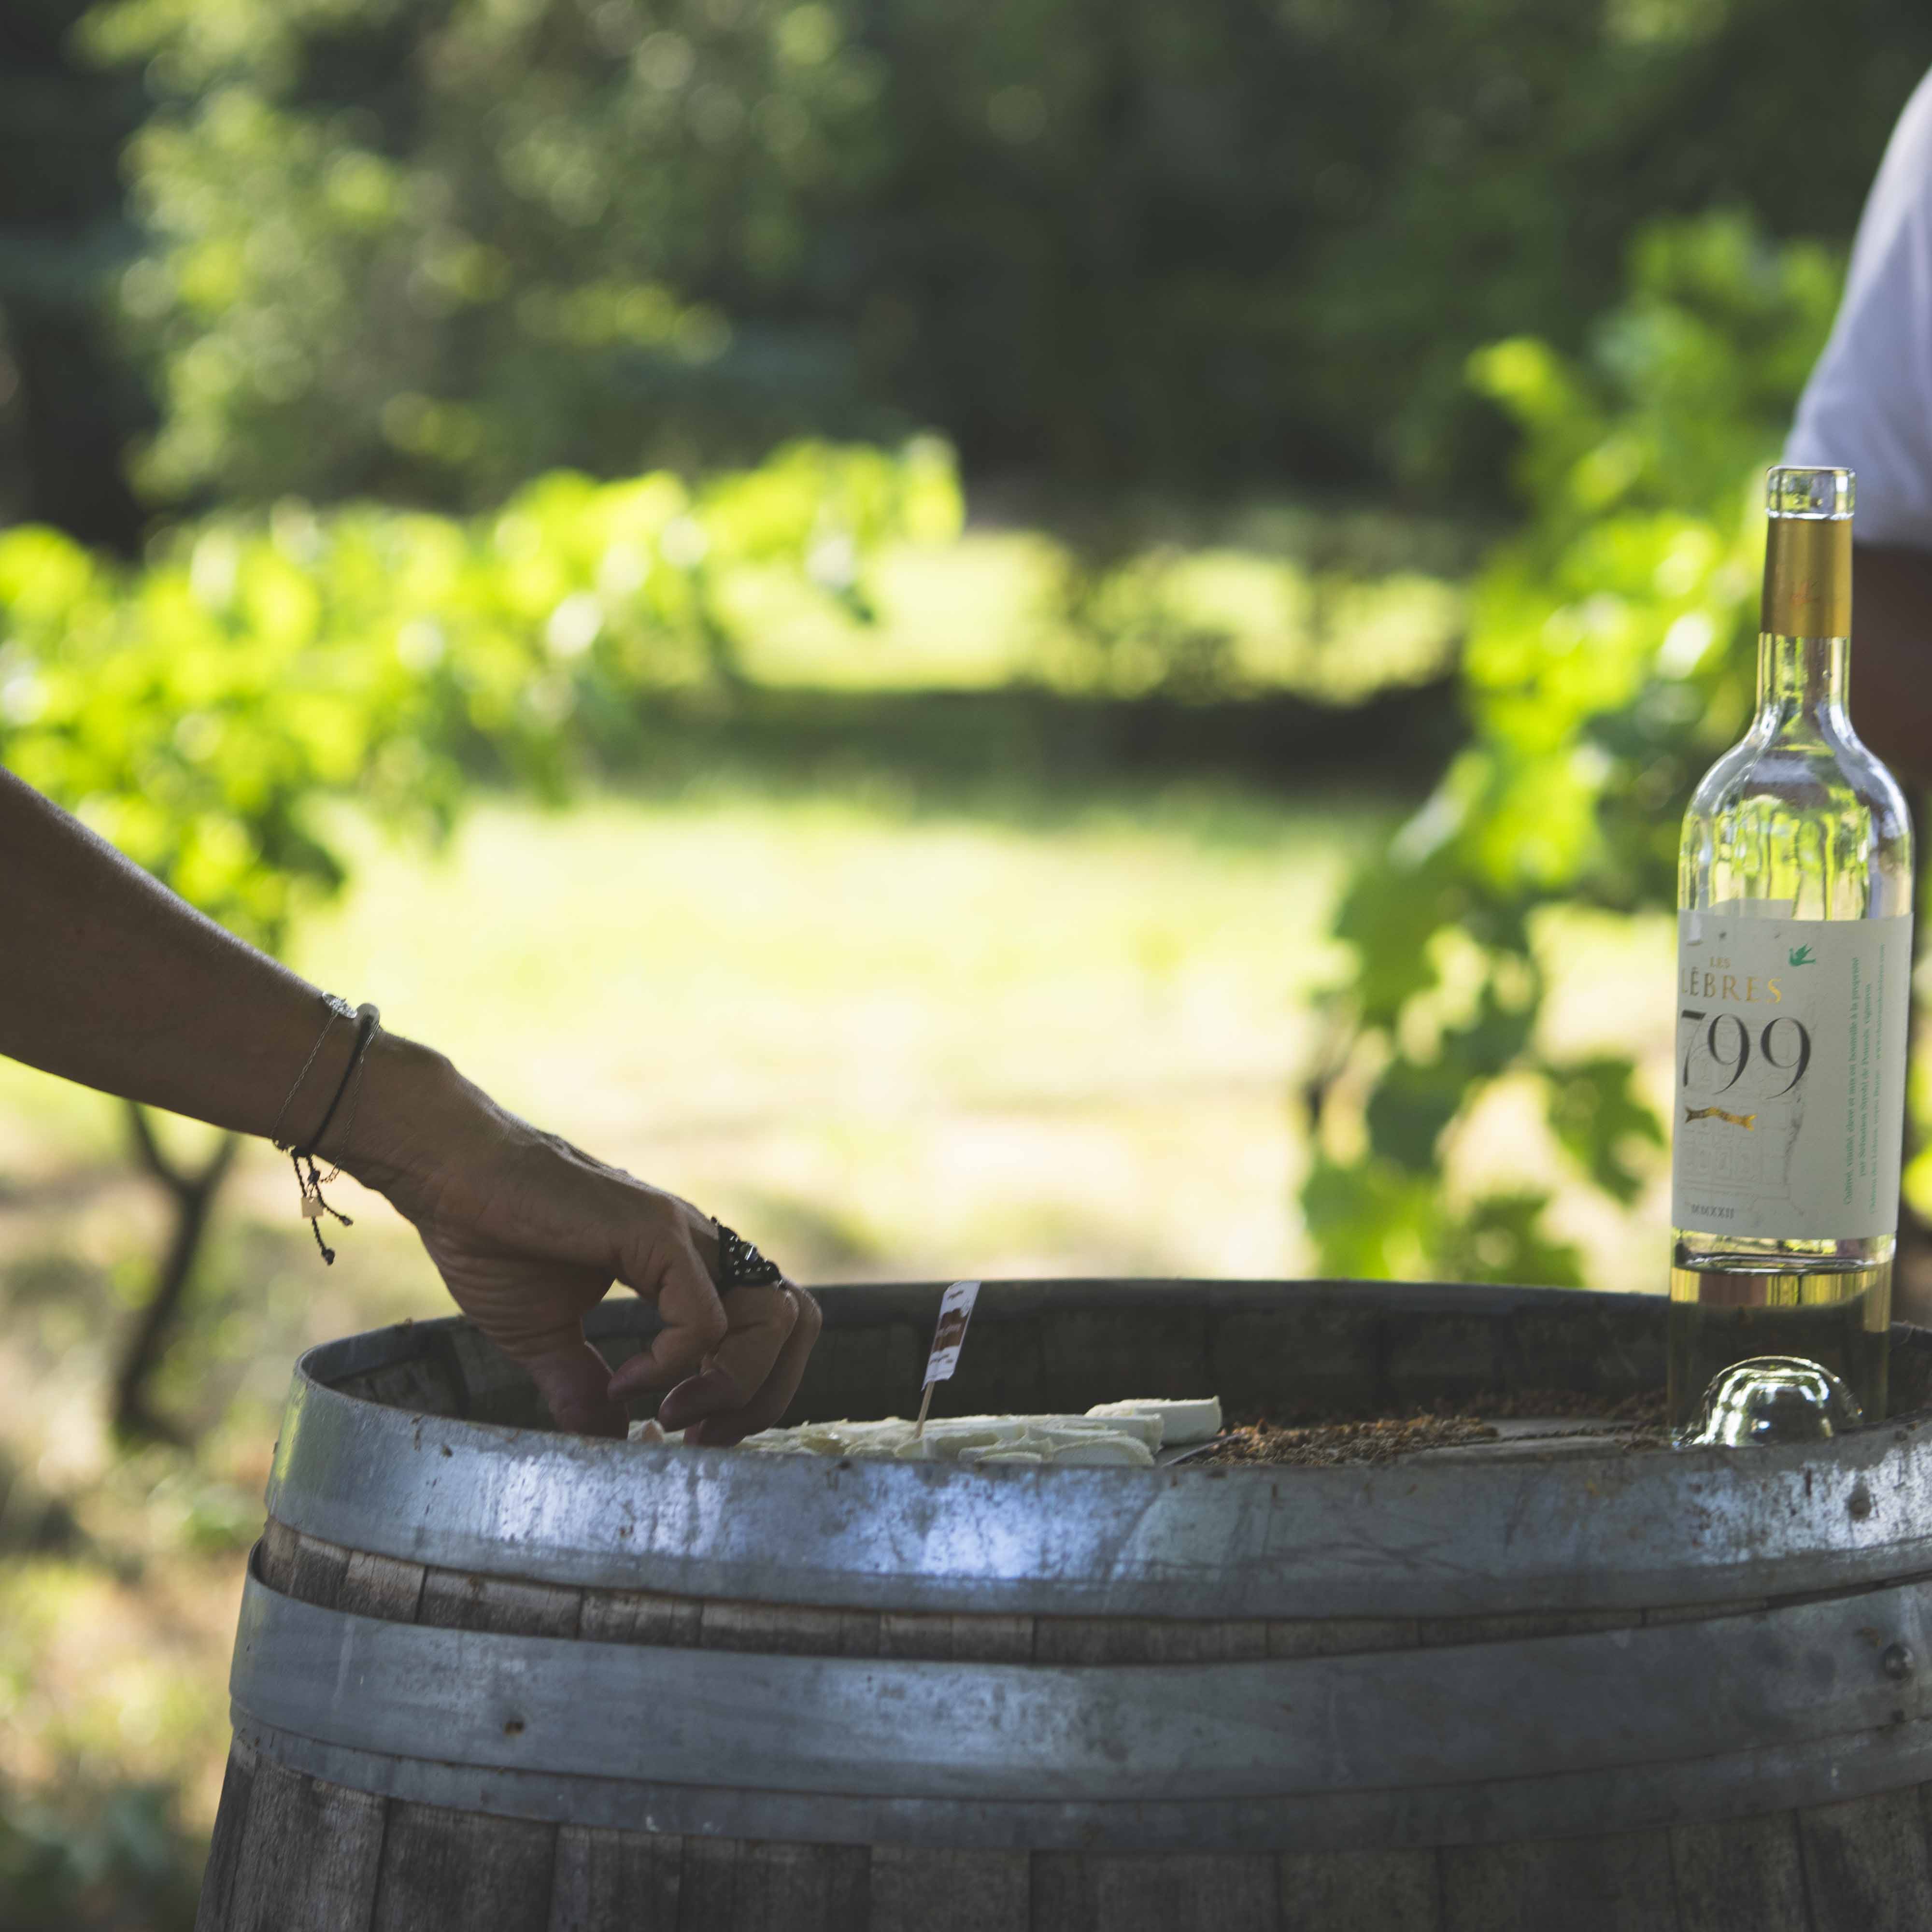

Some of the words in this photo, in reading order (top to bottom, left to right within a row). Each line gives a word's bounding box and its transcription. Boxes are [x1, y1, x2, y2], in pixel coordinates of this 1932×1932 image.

[1709, 956, 1731, 968] LES
[1681, 966, 1782, 1004] LÈBRES
[1681, 1009, 1810, 1099] 799
